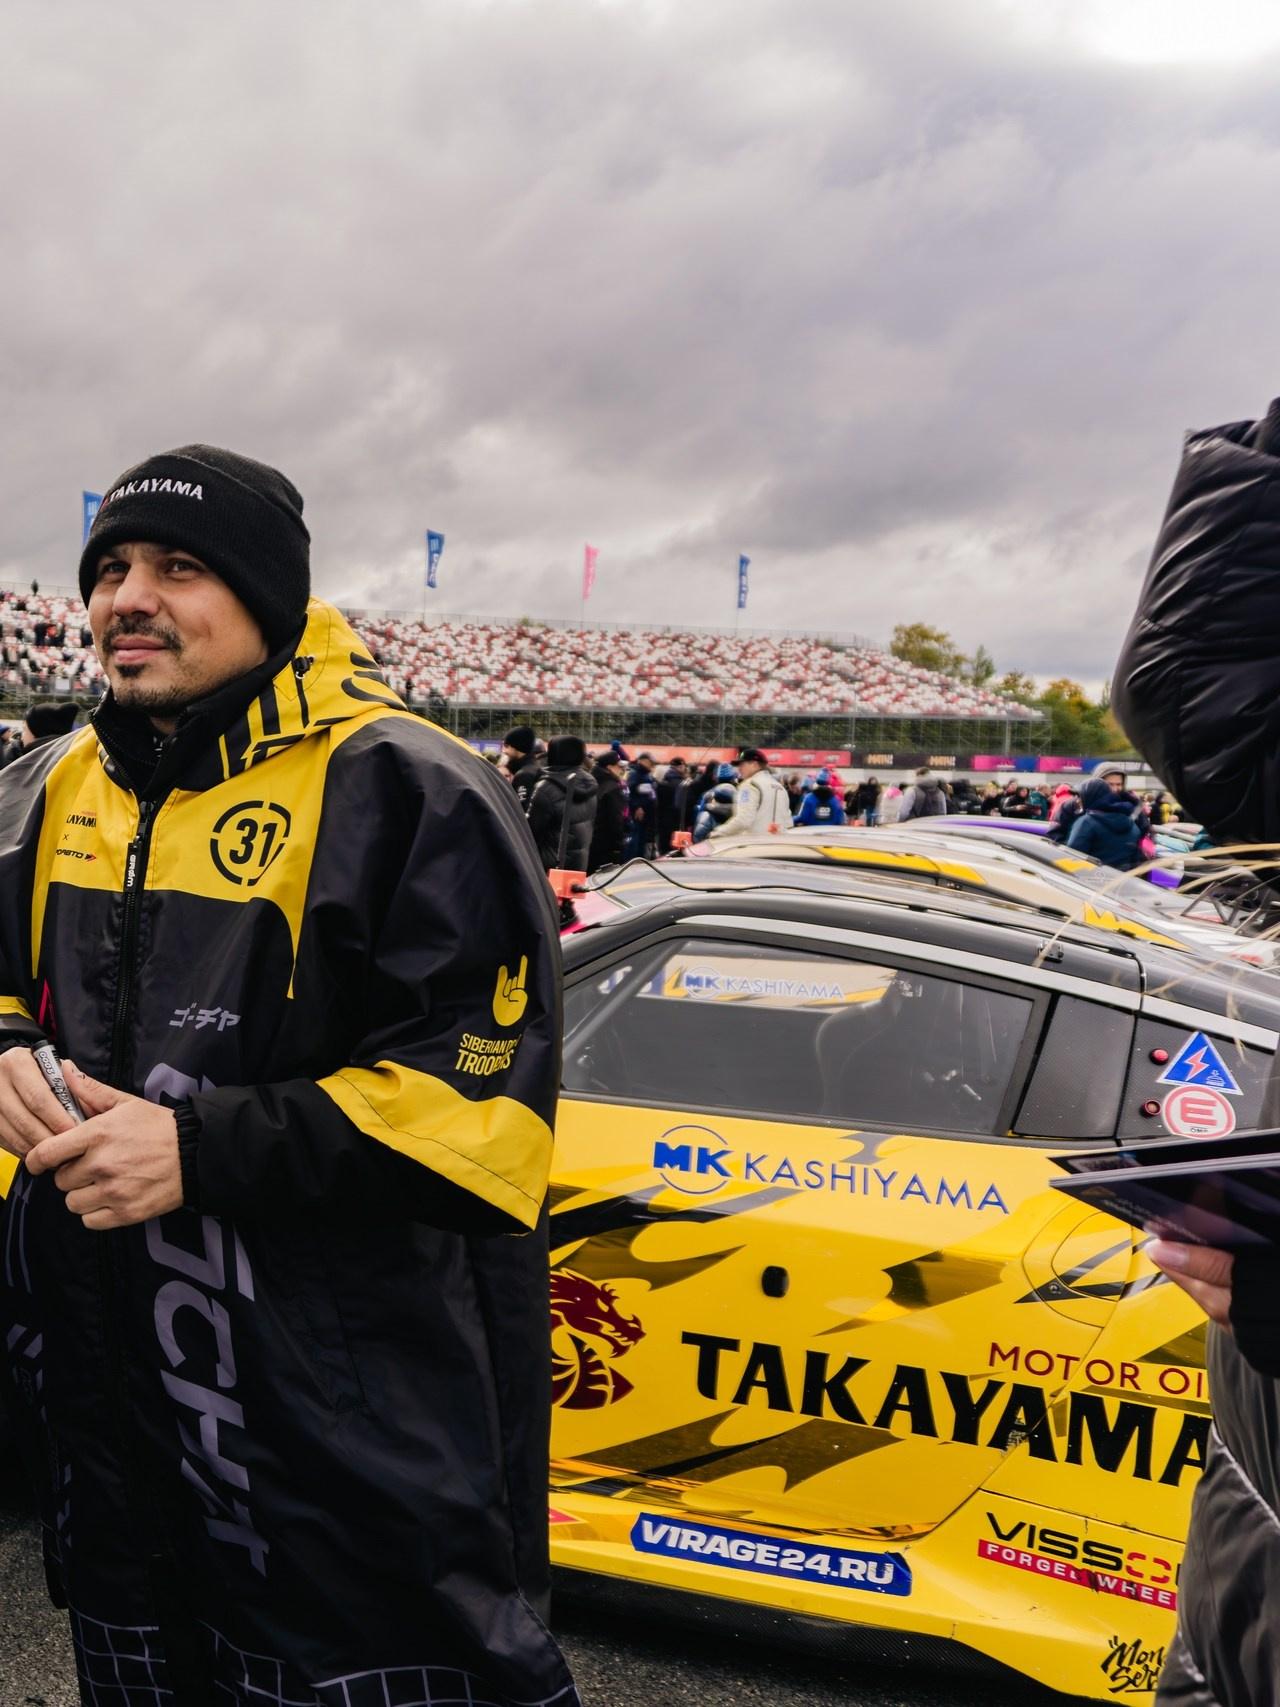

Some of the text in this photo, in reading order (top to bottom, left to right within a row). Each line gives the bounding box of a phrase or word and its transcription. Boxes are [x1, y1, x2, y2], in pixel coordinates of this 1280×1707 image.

[109, 478, 203, 500] TAKAYAMA
[228, 818, 278, 868] 31
[684, 974, 845, 1000] MK KASHIYAMA
[38, 1050, 56, 1076] 2000
[460, 1033, 505, 1054] SIBERIAN
[1180, 1097, 1218, 1127] E
[653, 1141, 1010, 1216] MK KASHIYAMA
[988, 1342, 1203, 1396] MOTOR OI
[681, 1330, 1213, 1488] TAKAYAMA
[641, 1519, 896, 1587] VIRAGE24.RU
[986, 1511, 1182, 1587] VISSO
[1097, 1573, 1171, 1605] WHEE
[1100, 1636, 1166, 1675] Mon
